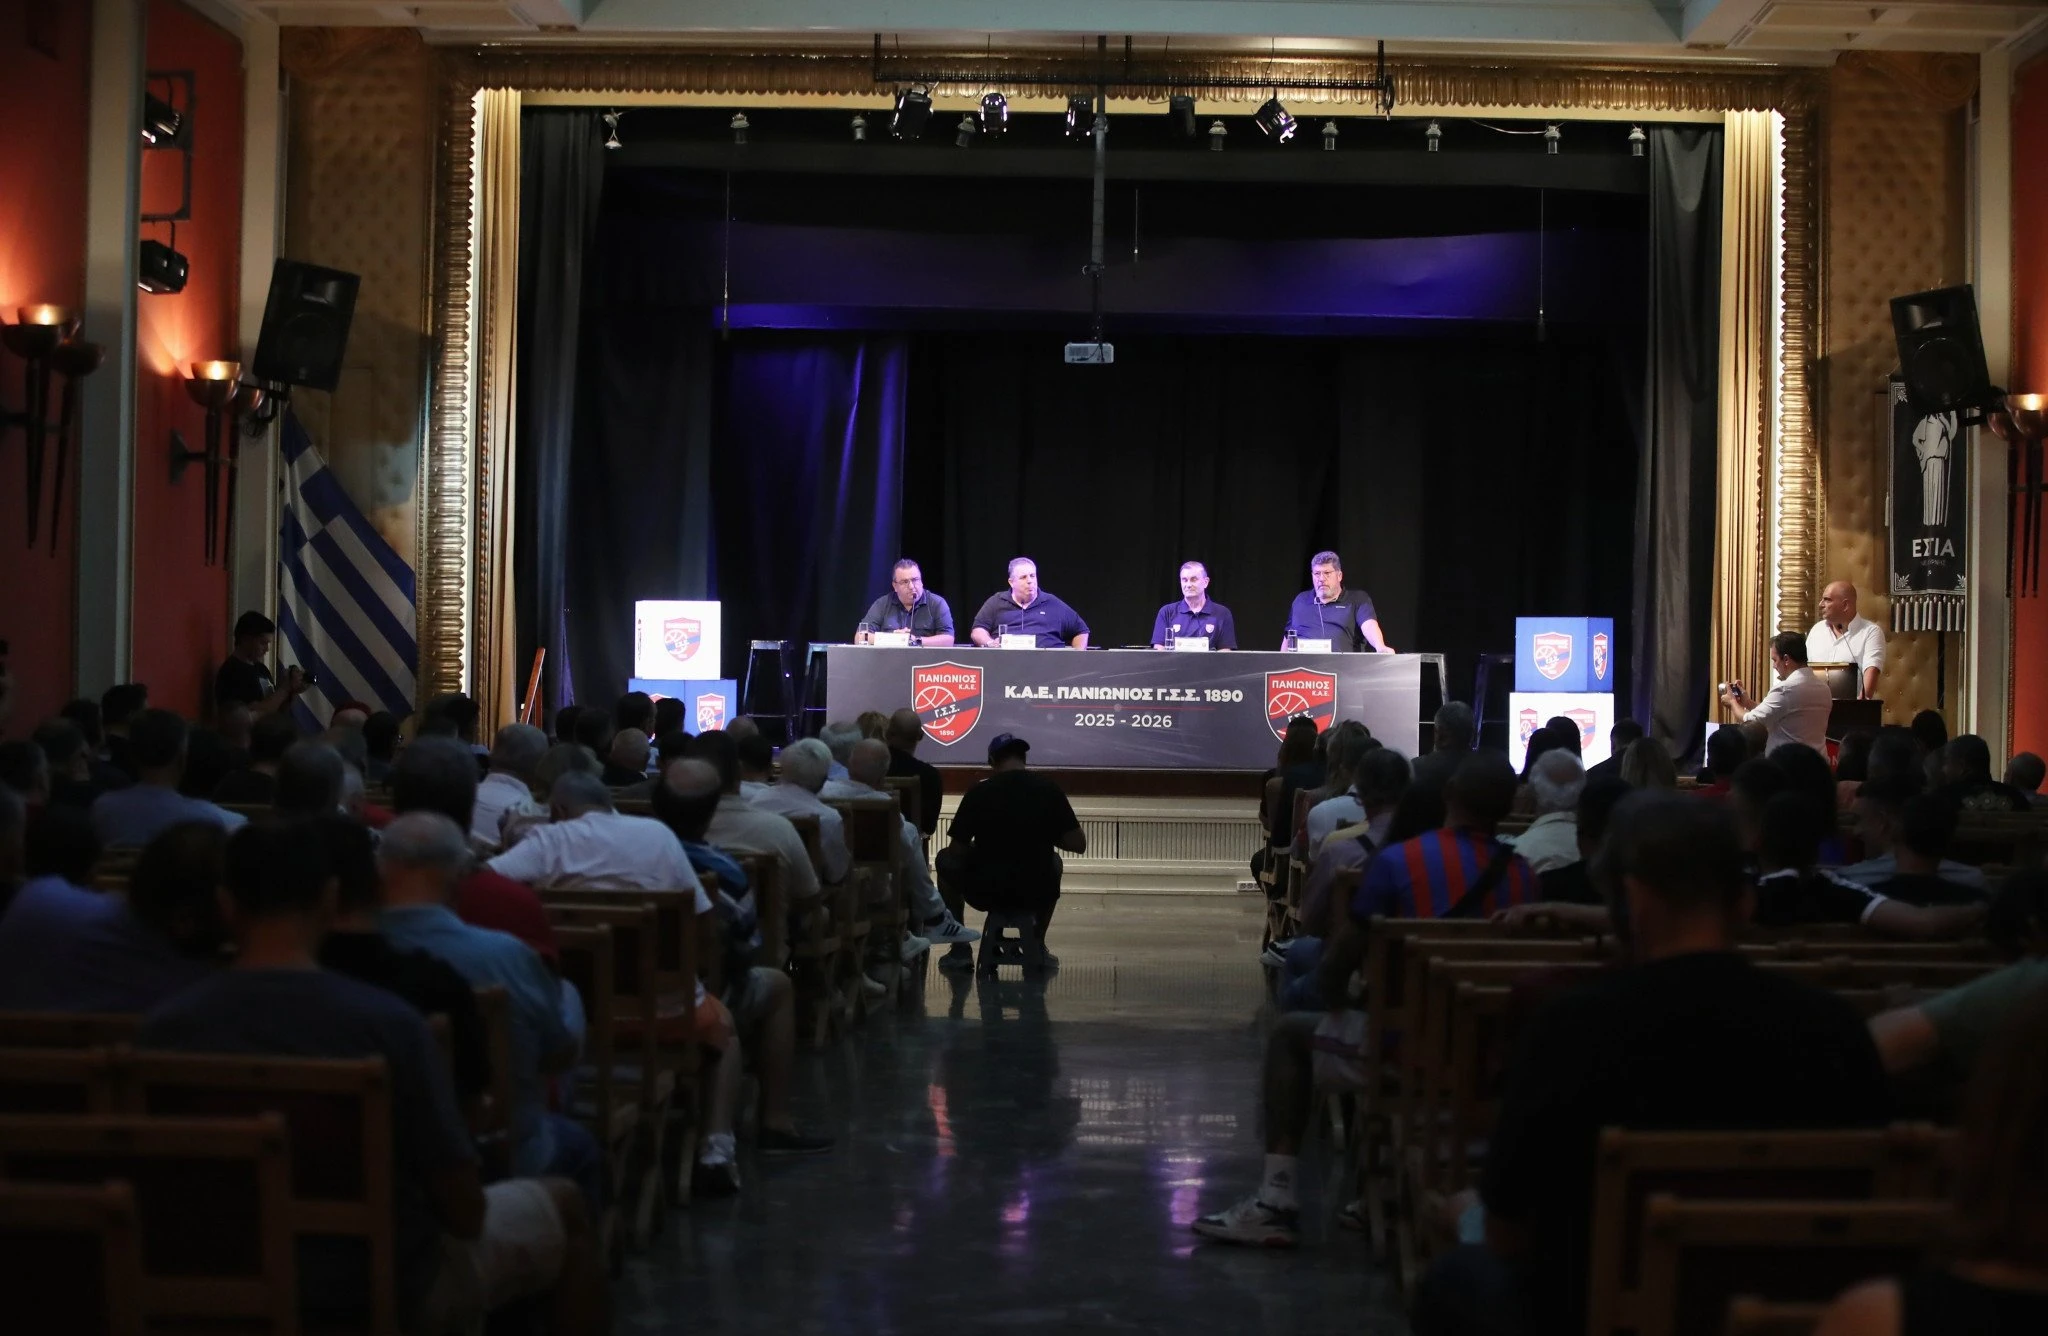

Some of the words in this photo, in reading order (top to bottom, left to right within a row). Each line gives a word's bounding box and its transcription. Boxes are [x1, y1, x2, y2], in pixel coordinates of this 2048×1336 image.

[918, 674, 977, 683] ΠΑΝΙΩΝΙΟΣ
[1272, 680, 1330, 690] ΠΑΝΙΩΝΙΟΣ
[1004, 685, 1053, 699] Κ.Α.Ε.
[1057, 686, 1153, 701] ΠΑΝΙΩΝΙΟΣ
[1156, 688, 1200, 702] Γ.Σ.Σ.
[1204, 689, 1244, 703] 1890
[934, 704, 960, 718] Γ.Σ.Σ.
[1074, 713, 1115, 727] 2025
[1131, 714, 1172, 728] 2026
